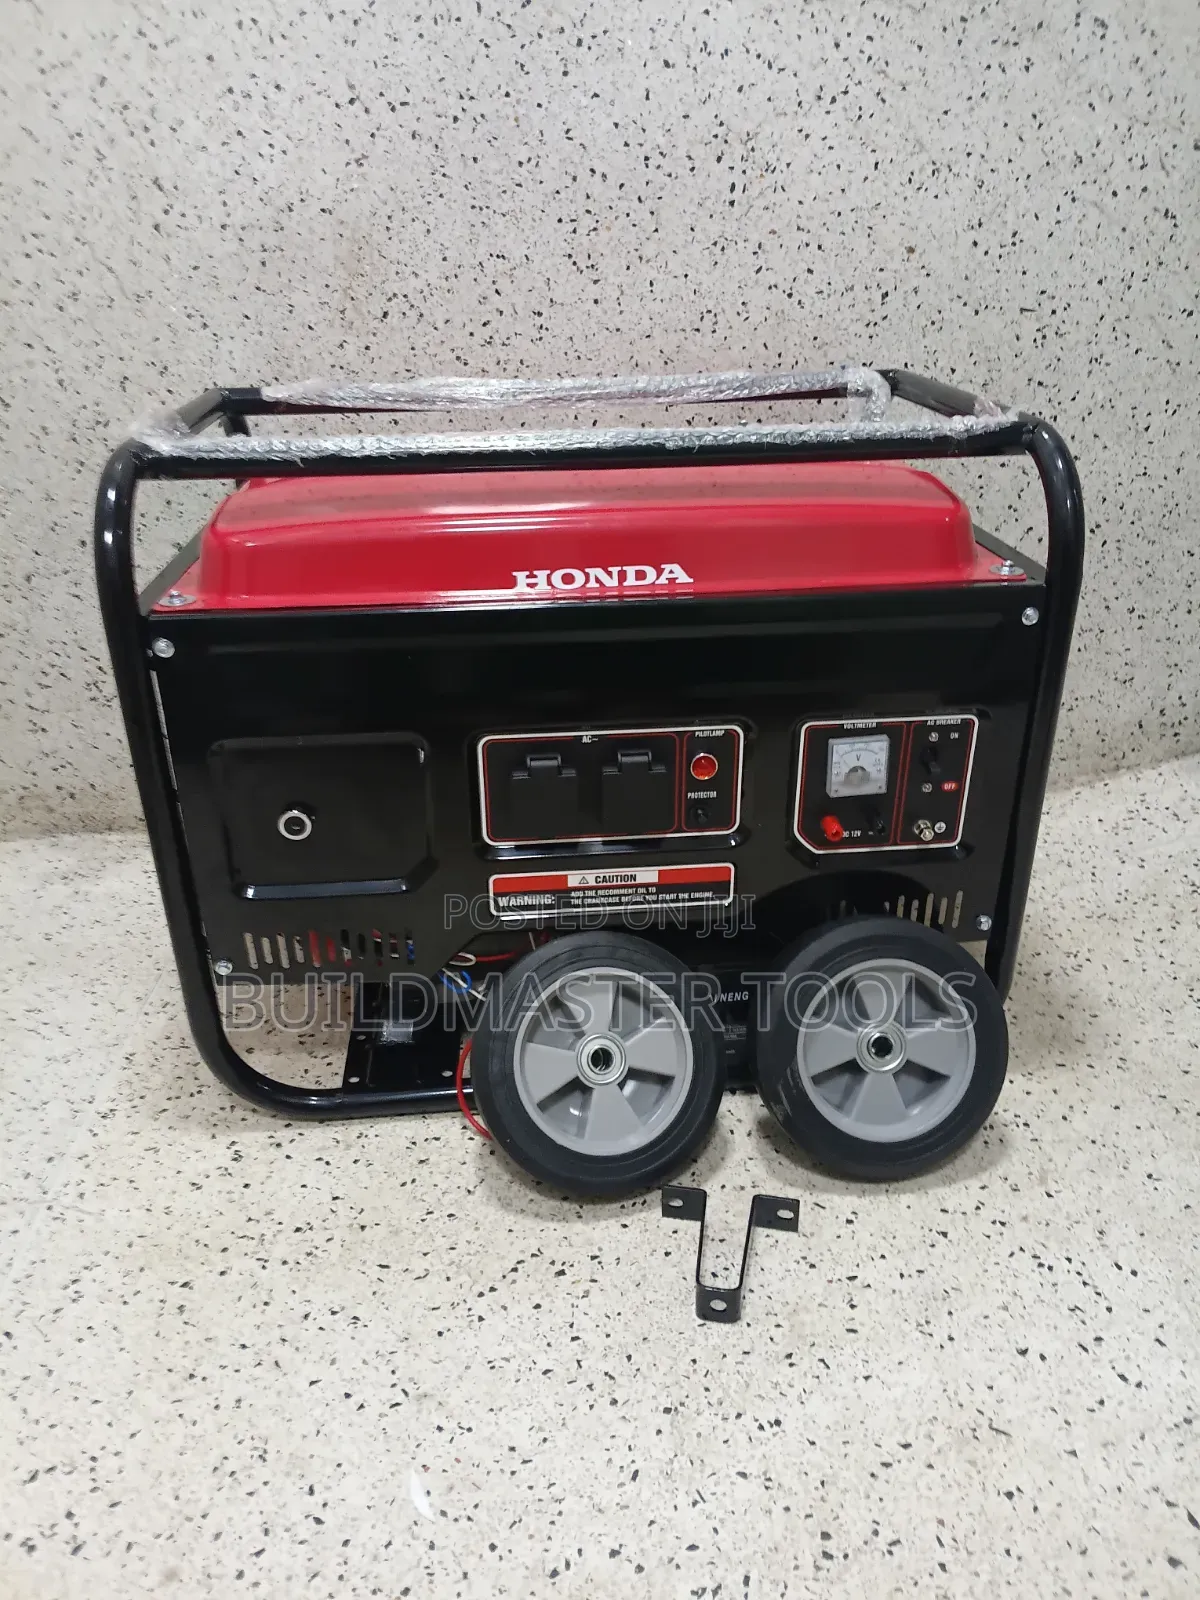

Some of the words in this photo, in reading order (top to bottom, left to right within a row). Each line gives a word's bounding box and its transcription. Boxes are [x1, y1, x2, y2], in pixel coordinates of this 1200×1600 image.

[512, 563, 694, 590] HONDA
[695, 729, 725, 738] PILOTLAMP
[687, 791, 717, 799] PROTECTOR
[595, 874, 637, 884] CAUTION
[570, 890, 584, 898] ADD
[499, 894, 555, 906] WARNING:
